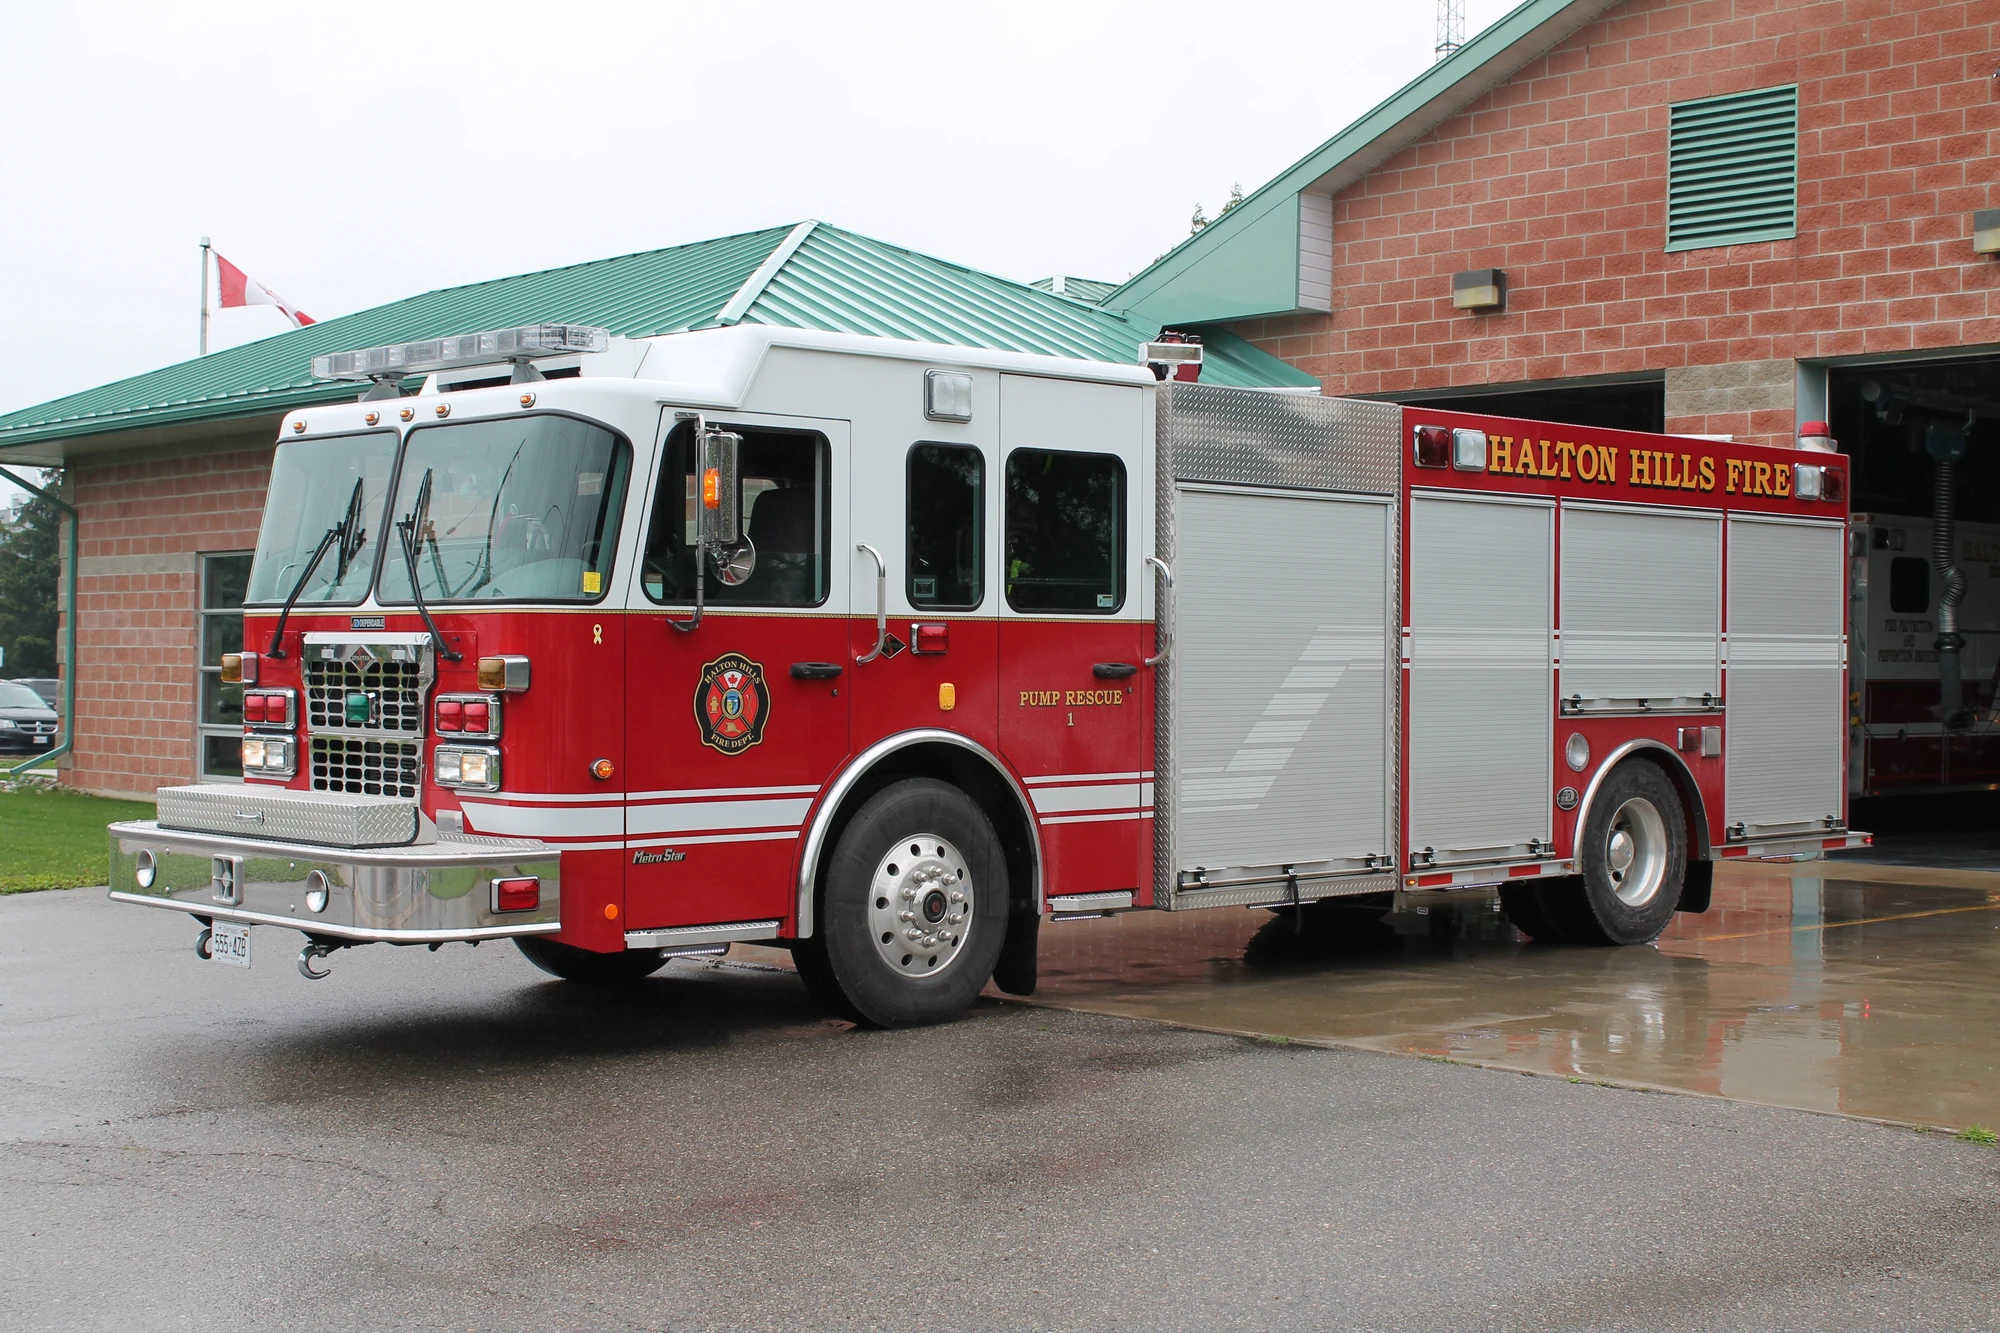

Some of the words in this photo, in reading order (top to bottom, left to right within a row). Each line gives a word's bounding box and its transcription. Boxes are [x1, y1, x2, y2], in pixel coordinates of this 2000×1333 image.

[1488, 434, 1618, 483] HALTON
[1629, 448, 1716, 492] HILLS
[1725, 458, 1791, 498] FIRE
[704, 660, 738, 684] HALTON
[739, 661, 761, 685] HILLS
[1019, 691, 1061, 706] PUMP
[1065, 690, 1123, 705] RESCUE
[1067, 712, 1075, 726] 1
[711, 732, 730, 748] FIRE
[731, 732, 755, 748] DEPT.
[632, 850, 663, 864] Metro
[663, 848, 686, 862] Star
